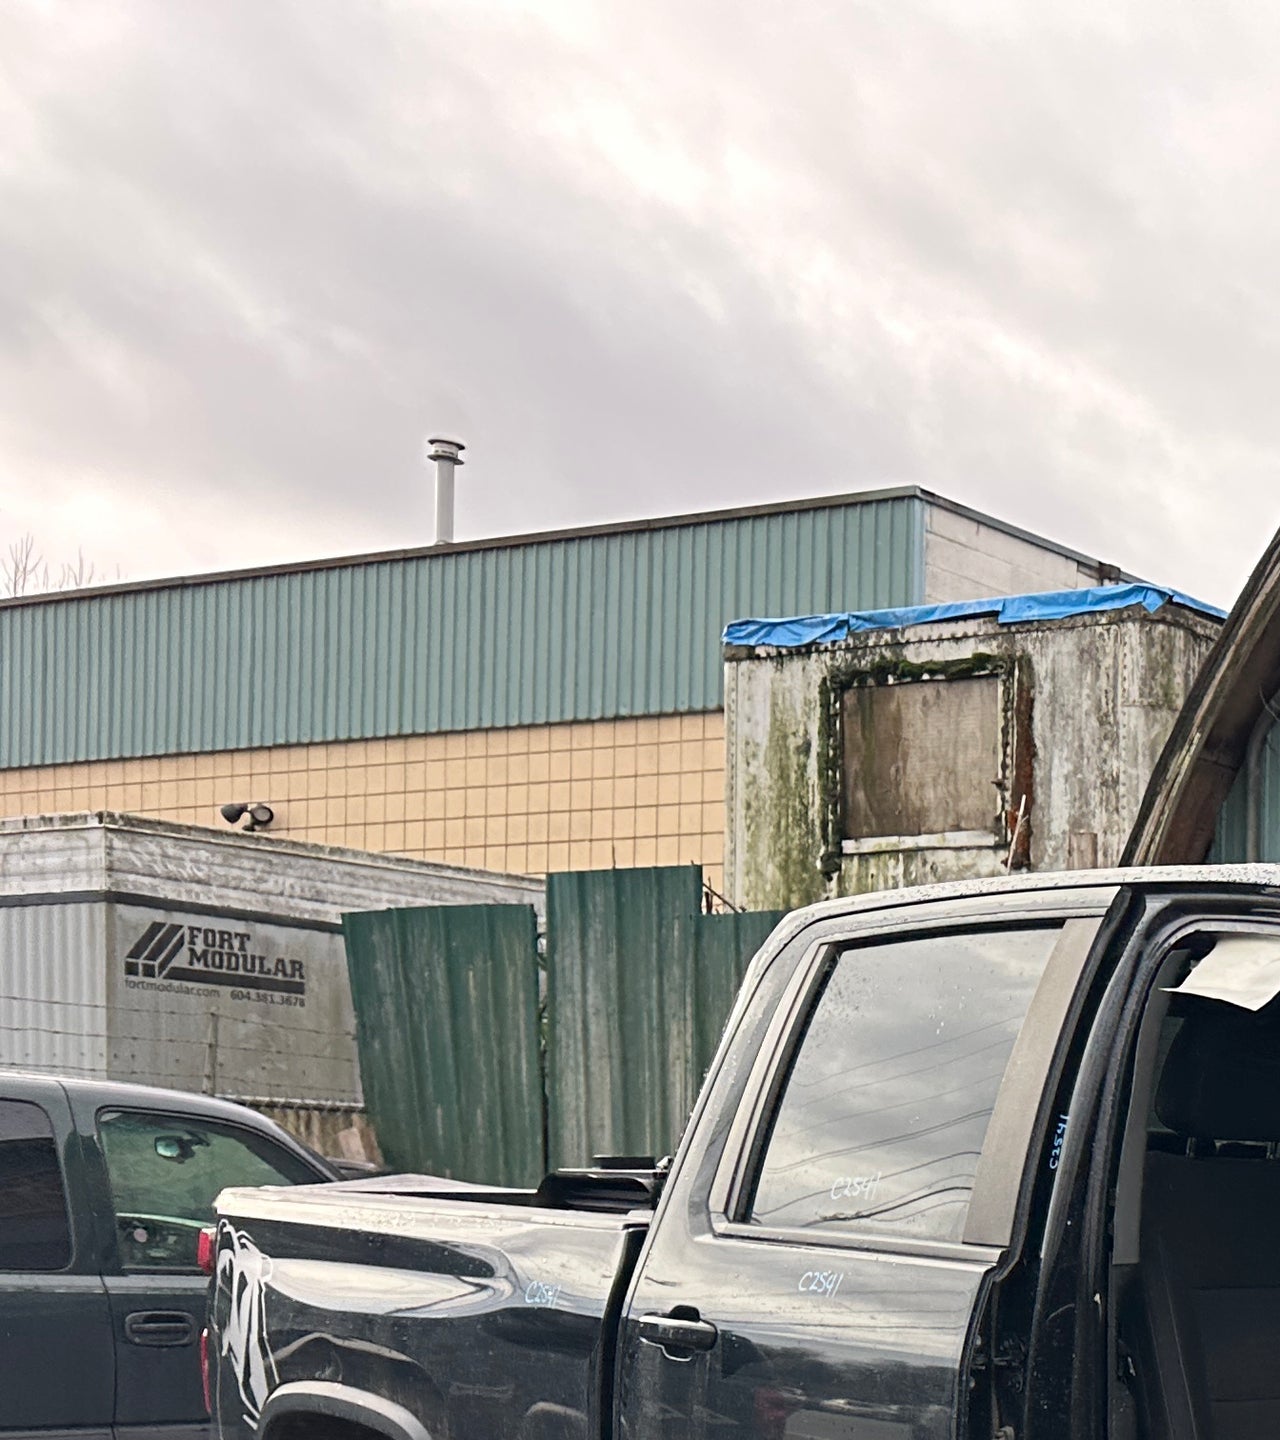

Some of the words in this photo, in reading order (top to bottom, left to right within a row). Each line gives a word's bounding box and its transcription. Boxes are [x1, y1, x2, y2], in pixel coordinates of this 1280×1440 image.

[187, 925, 251, 952] FORT
[187, 947, 306, 980] MODULAR
[124, 978, 221, 998] fortmodular.com
[1049, 1114, 1070, 1169] C2541
